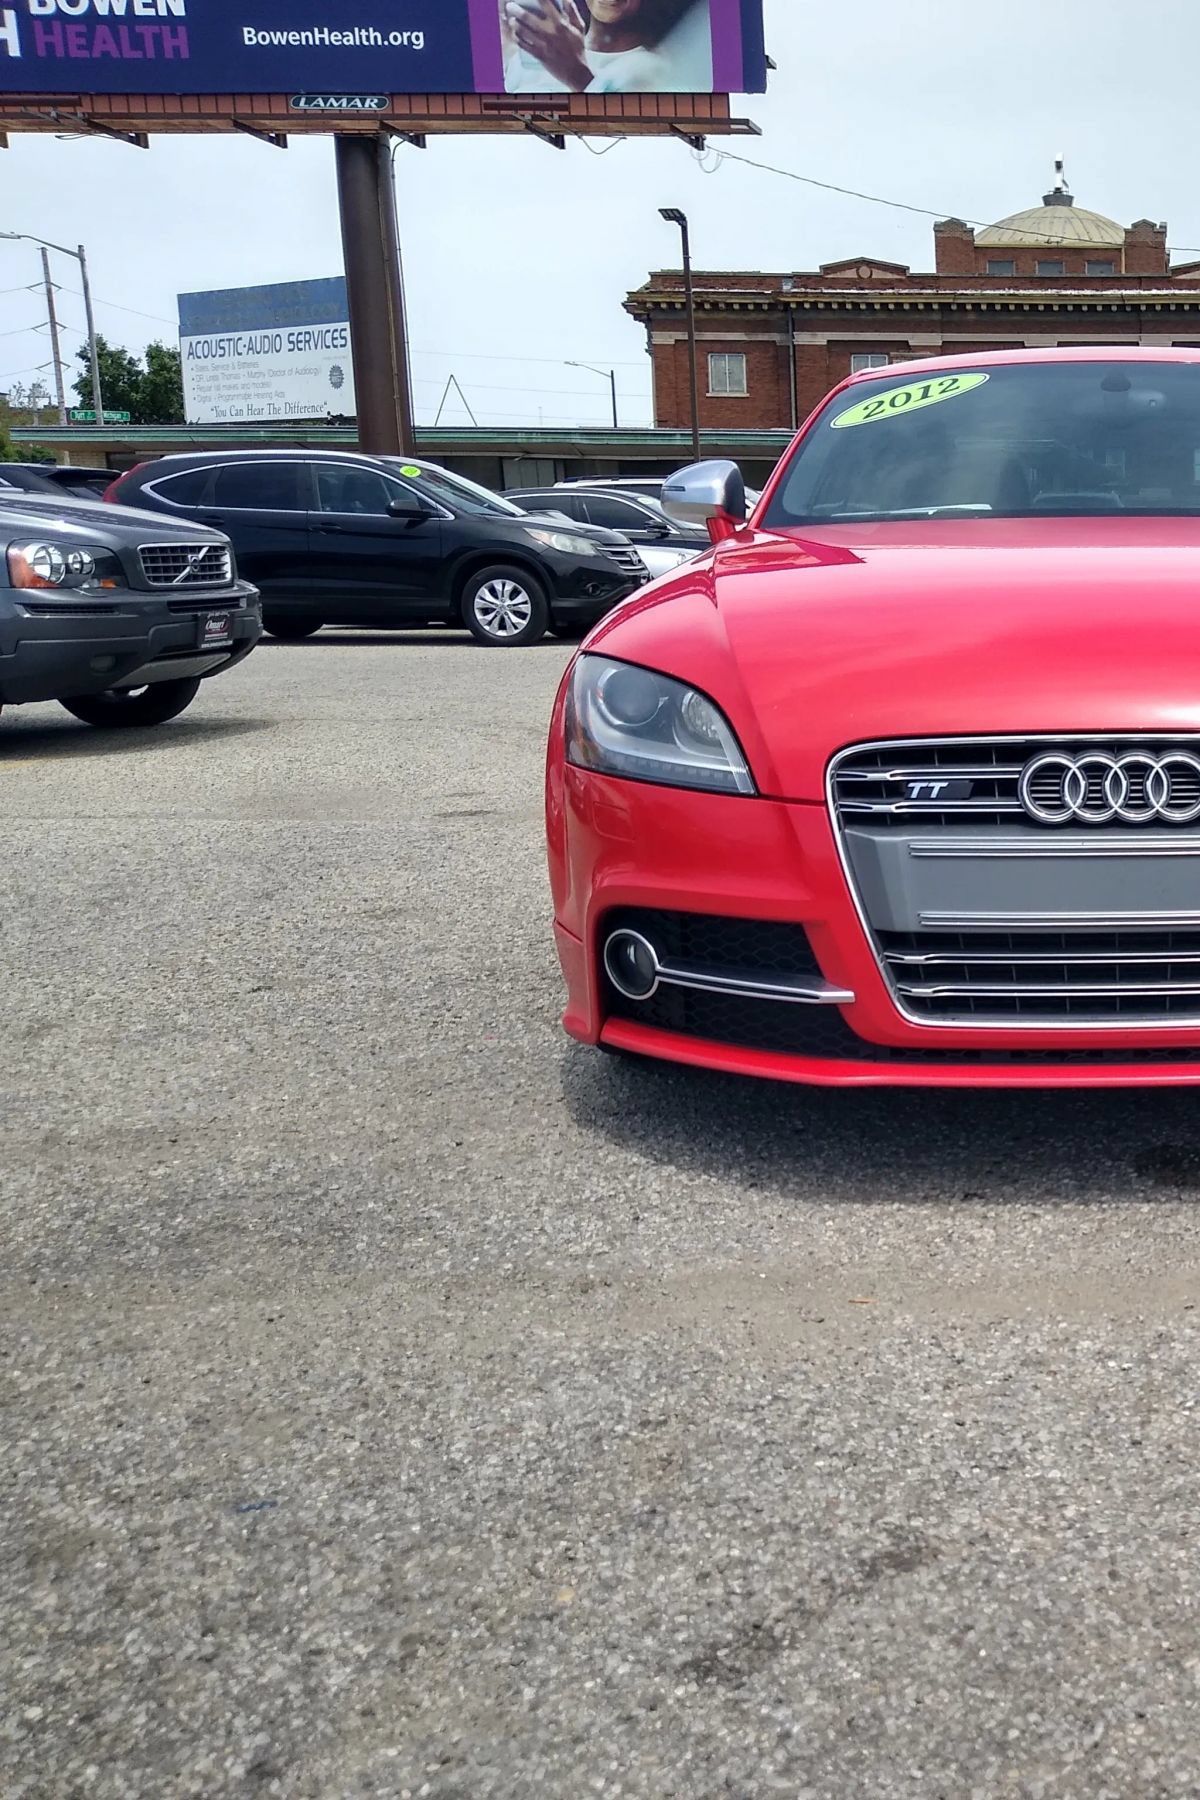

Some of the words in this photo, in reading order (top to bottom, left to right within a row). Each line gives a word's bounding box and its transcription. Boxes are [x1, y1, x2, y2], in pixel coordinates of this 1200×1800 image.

[33, 20, 190, 58] HEALTH
[243, 27, 425, 49] BowenHealth.org
[299, 97, 379, 109] LAMAR
[287, 328, 348, 352] SERVICES
[229, 404, 244, 417] Can
[246, 403, 264, 416] Hear
[267, 402, 282, 415] The
[862, 378, 961, 420] 2012
[907, 782, 949, 799] TT
